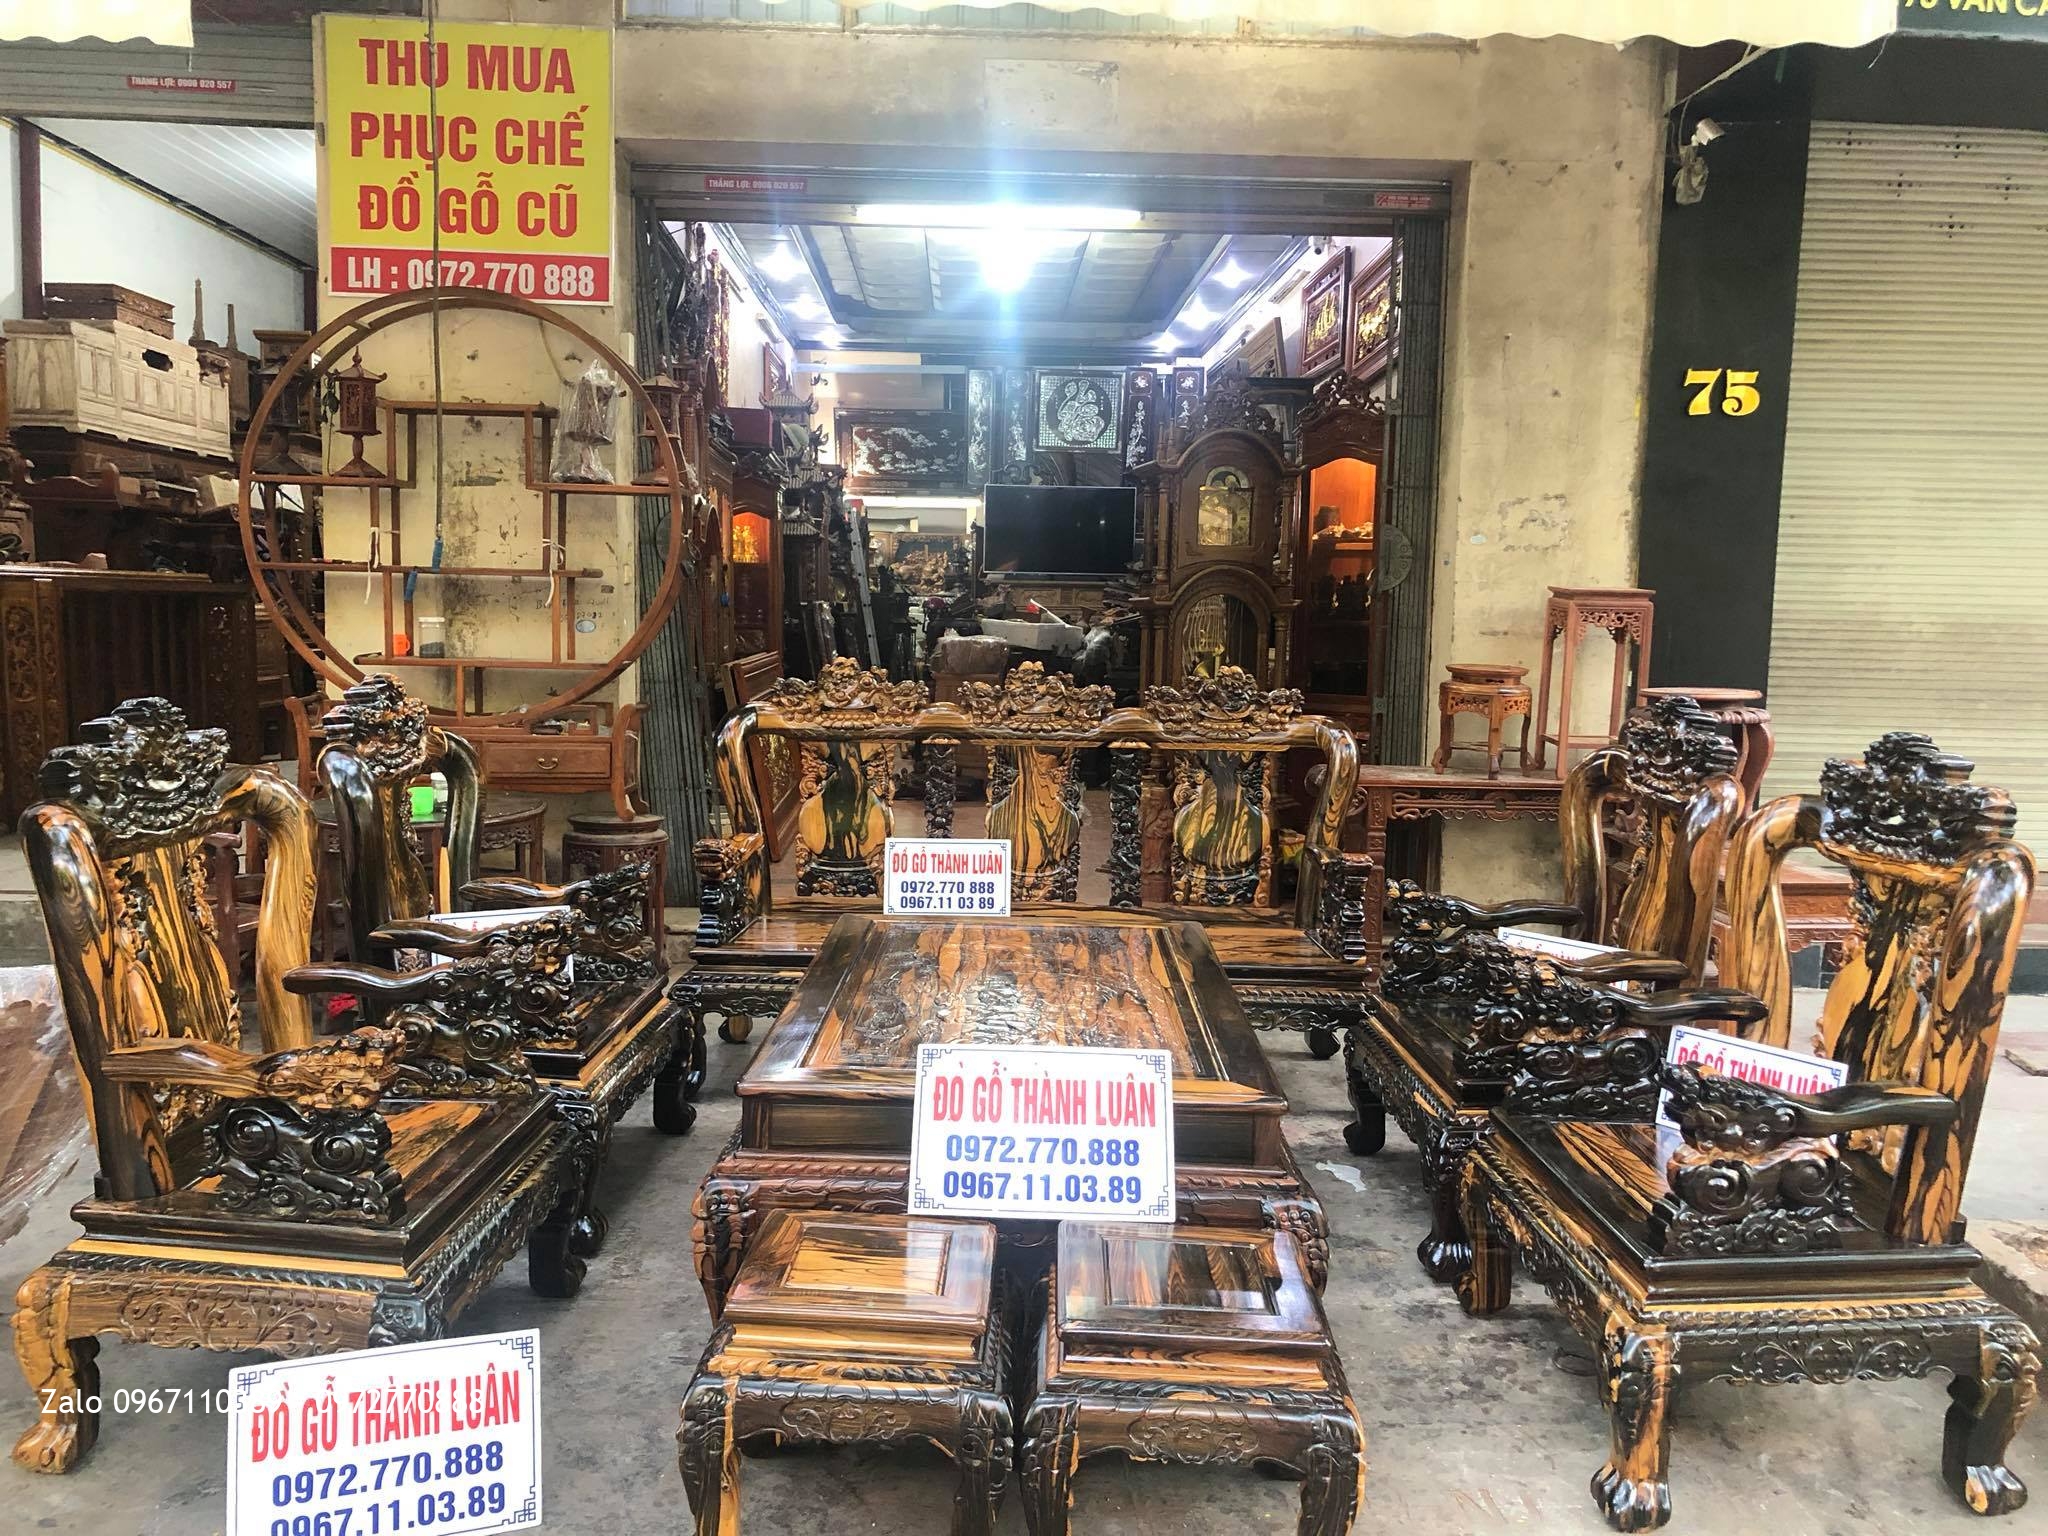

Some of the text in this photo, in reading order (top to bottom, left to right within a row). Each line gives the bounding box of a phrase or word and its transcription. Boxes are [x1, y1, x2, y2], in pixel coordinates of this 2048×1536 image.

[199, 79, 215, 88] 020
[216, 80, 232, 89] 557
[358, 38, 575, 94] THU MUA
[350, 105, 589, 171] PHỤC CHẾ
[357, 171, 578, 238] ĐỒ GỖ CŨ
[789, 182, 805, 190] 557
[347, 256, 381, 289] LH
[390, 266, 399, 289] :
[544, 264, 595, 297] 888
[1683, 368, 1760, 417] 75
[912, 846, 927, 874] GỖ
[930, 850, 969, 874] THÀNH
[972, 850, 1003, 875] LUÂN
[969, 882, 995, 894] 888
[972, 1061, 1002, 1123] GỖ
[1010, 1070, 1087, 1125] THÀNH
[1095, 1072, 1156, 1128] LUÂN
[946, 1134, 1140, 1167] 0972.770.888
[943, 1171, 1142, 1204] 0967.11.03.89
[251, 1362, 521, 1463] ĐỒ GỖ THÀNH LUÂN
[272, 1440, 504, 1507] 0972.770.888
[270, 1482, 506, 1536] 0967.11.03.89
